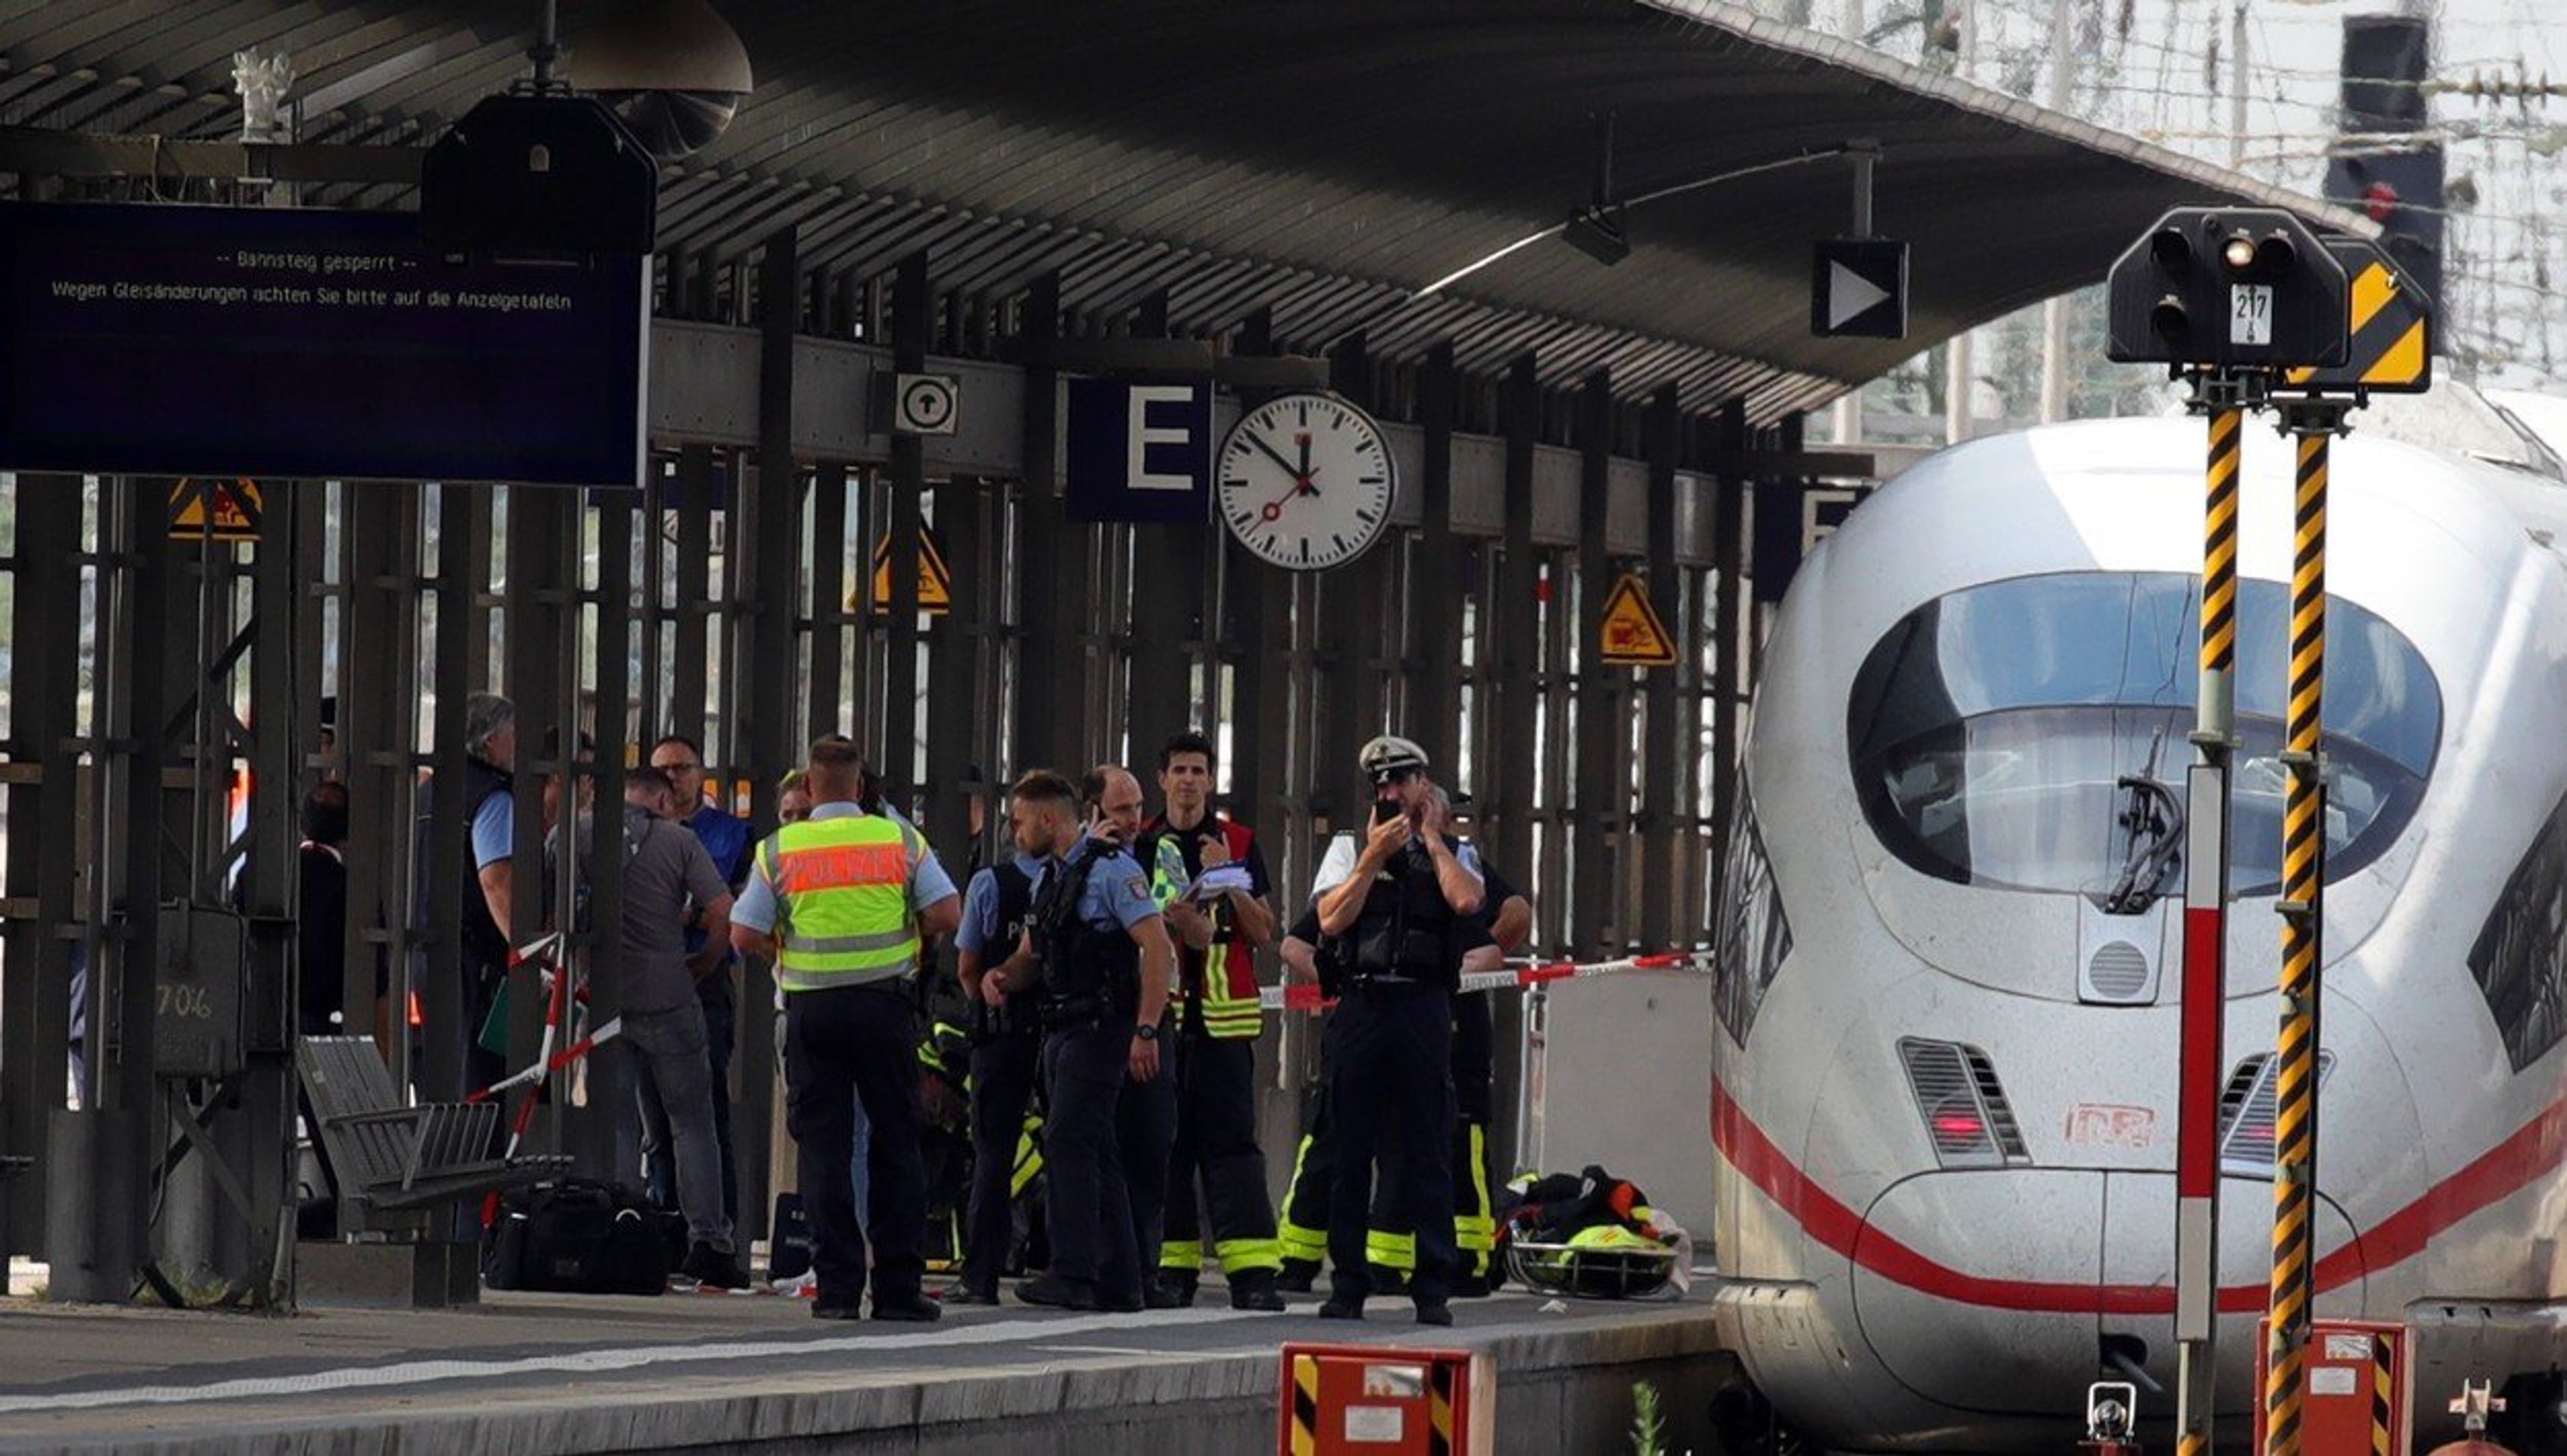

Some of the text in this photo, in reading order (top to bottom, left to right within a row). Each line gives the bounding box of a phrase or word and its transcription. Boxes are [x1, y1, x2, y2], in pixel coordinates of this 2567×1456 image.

[237, 249, 317, 274] Bahnsteig
[323, 256, 395, 275] gesperrt
[51, 281, 573, 312] Wegen Gleisänderungen achten Sie bitte auf die Anzeigetafeln
[2236, 293, 2267, 318] 217
[1127, 385, 1194, 490] E
